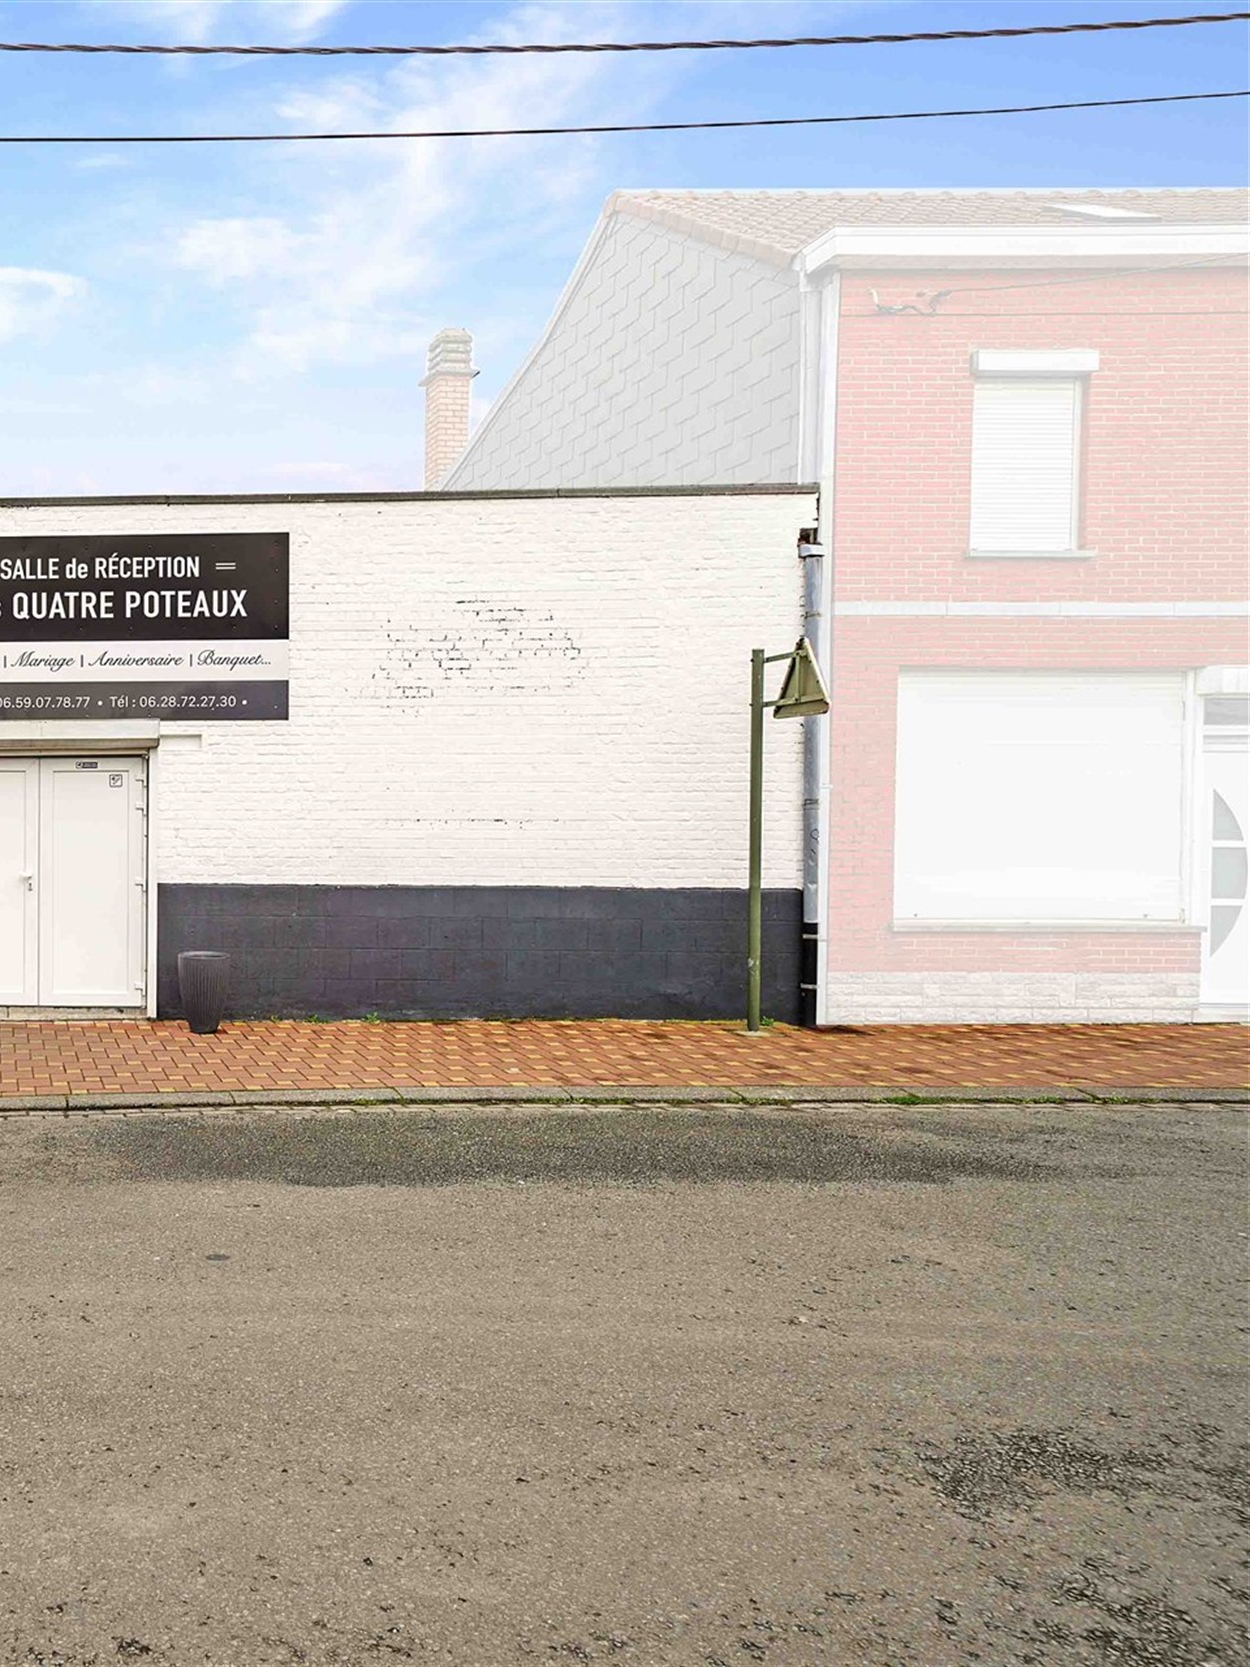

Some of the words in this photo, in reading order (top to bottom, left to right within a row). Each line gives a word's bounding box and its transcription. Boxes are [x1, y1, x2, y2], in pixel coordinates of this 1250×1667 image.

[0, 558, 59, 580] SALLE
[65, 558, 88, 579] de
[95, 552, 200, 579] RÉCEPTION
[12, 591, 115, 620] QUATRE
[125, 589, 248, 618] POTEAUX
[10, 651, 75, 673] Mariage
[88, 650, 184, 667] Anniversaire
[139, 695, 237, 708] 06.28.72.27.30
